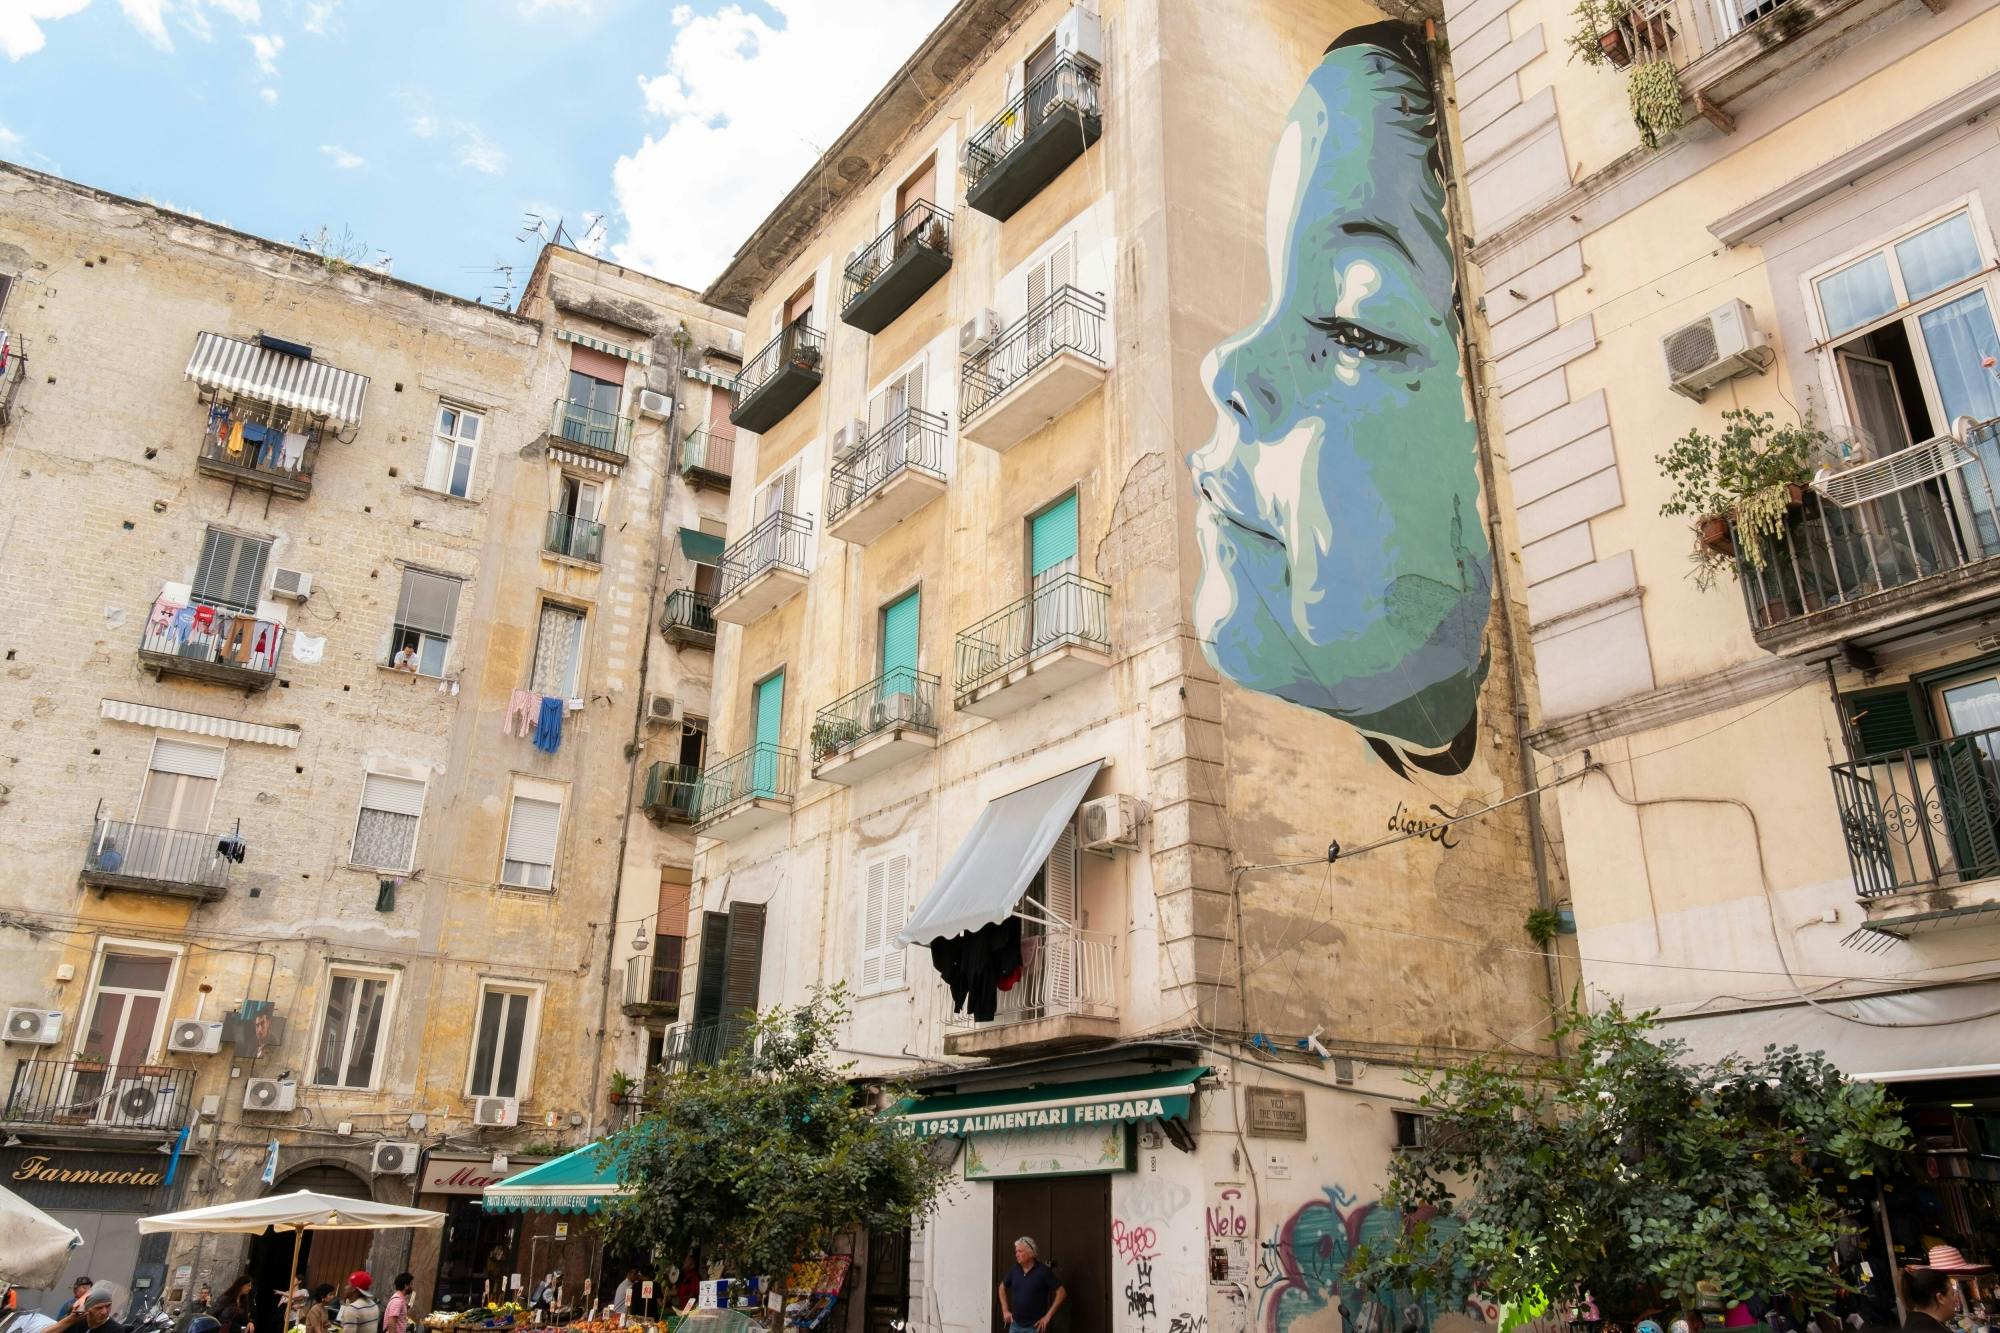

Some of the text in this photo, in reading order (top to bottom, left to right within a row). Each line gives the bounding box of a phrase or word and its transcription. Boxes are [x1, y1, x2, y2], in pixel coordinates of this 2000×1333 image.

[922, 1119, 959, 1135] 1953
[962, 1108, 1068, 1133] ALIMENTARI
[1074, 1099, 1164, 1123] FERRARA
[12, 1156, 163, 1185] Farmacia
[1206, 1205, 1247, 1237] Nelo
